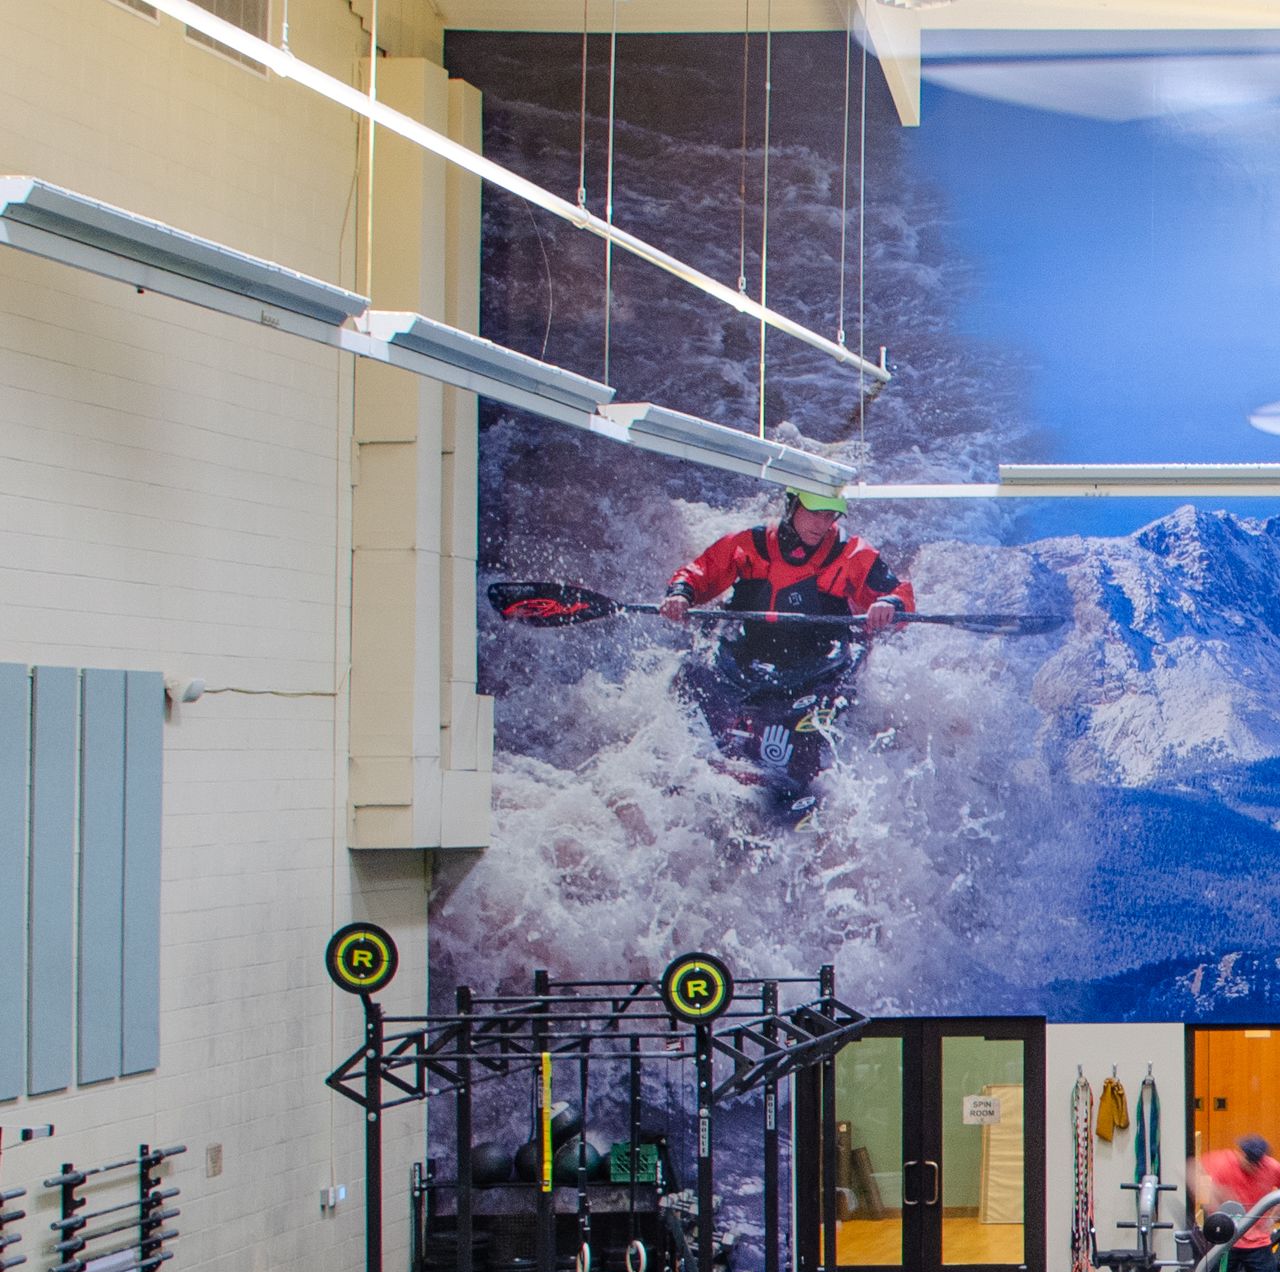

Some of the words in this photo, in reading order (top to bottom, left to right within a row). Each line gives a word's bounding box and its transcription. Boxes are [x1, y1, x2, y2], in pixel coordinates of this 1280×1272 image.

[353, 947, 374, 970] R
[686, 978, 709, 999] R
[972, 1100, 992, 1108] SPIN
